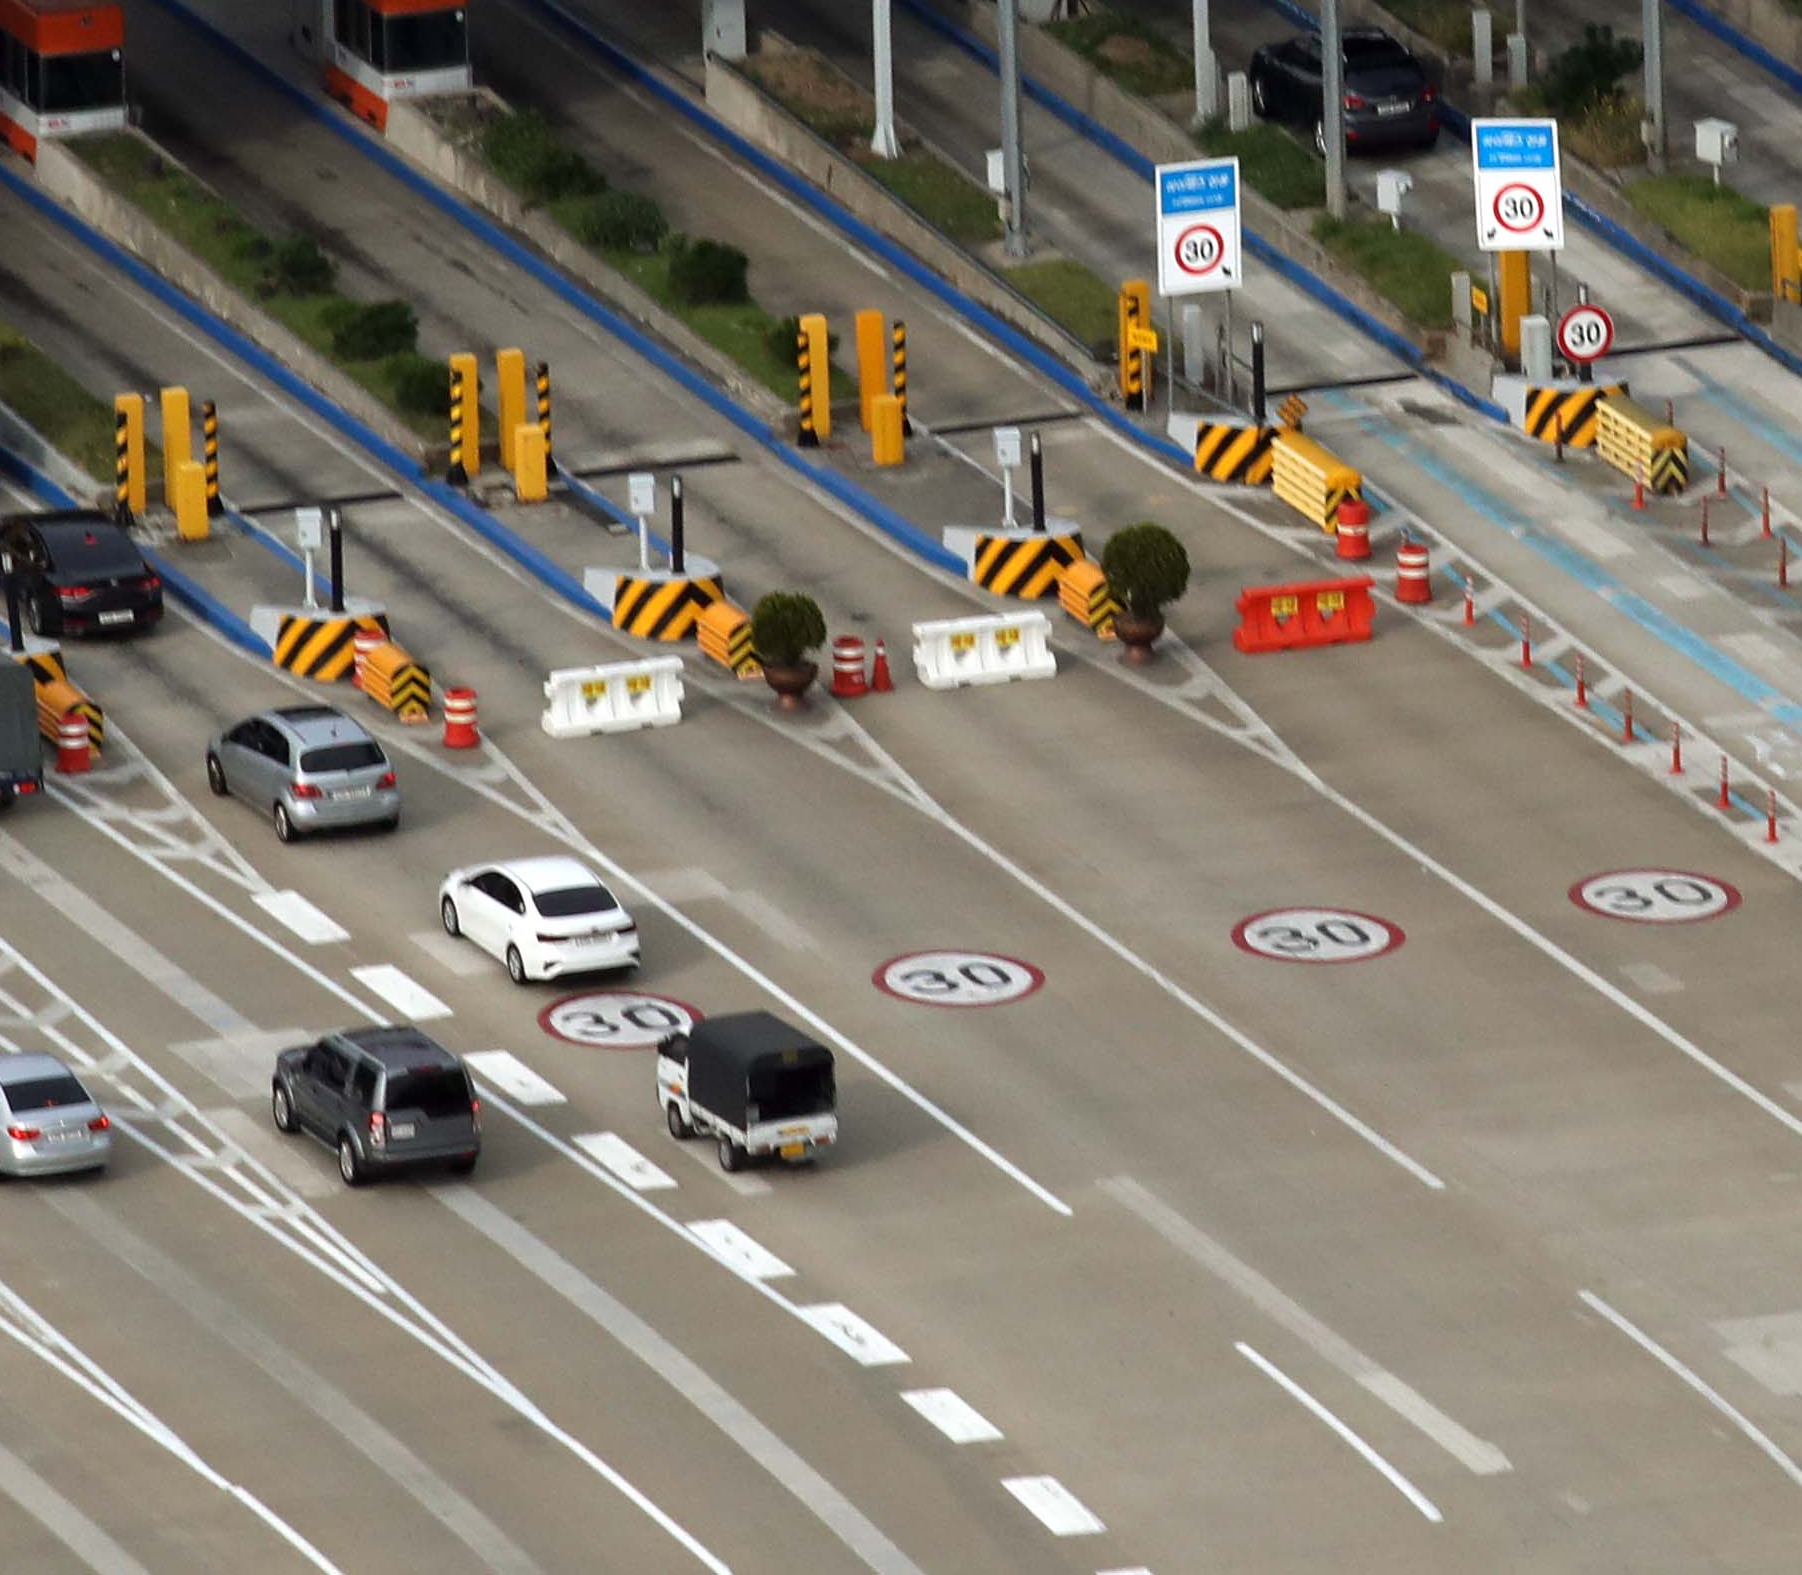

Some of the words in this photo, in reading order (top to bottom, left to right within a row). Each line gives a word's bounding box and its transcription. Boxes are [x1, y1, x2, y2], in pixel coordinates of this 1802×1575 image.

[1504, 197, 1534, 220] 30
[1185, 238, 1214, 264] 30
[1570, 322, 1602, 348] 30
[1595, 876, 1713, 911] 30
[1268, 916, 1372, 947] 30
[901, 961, 1012, 991] 30
[563, 1004, 680, 1037] 30
